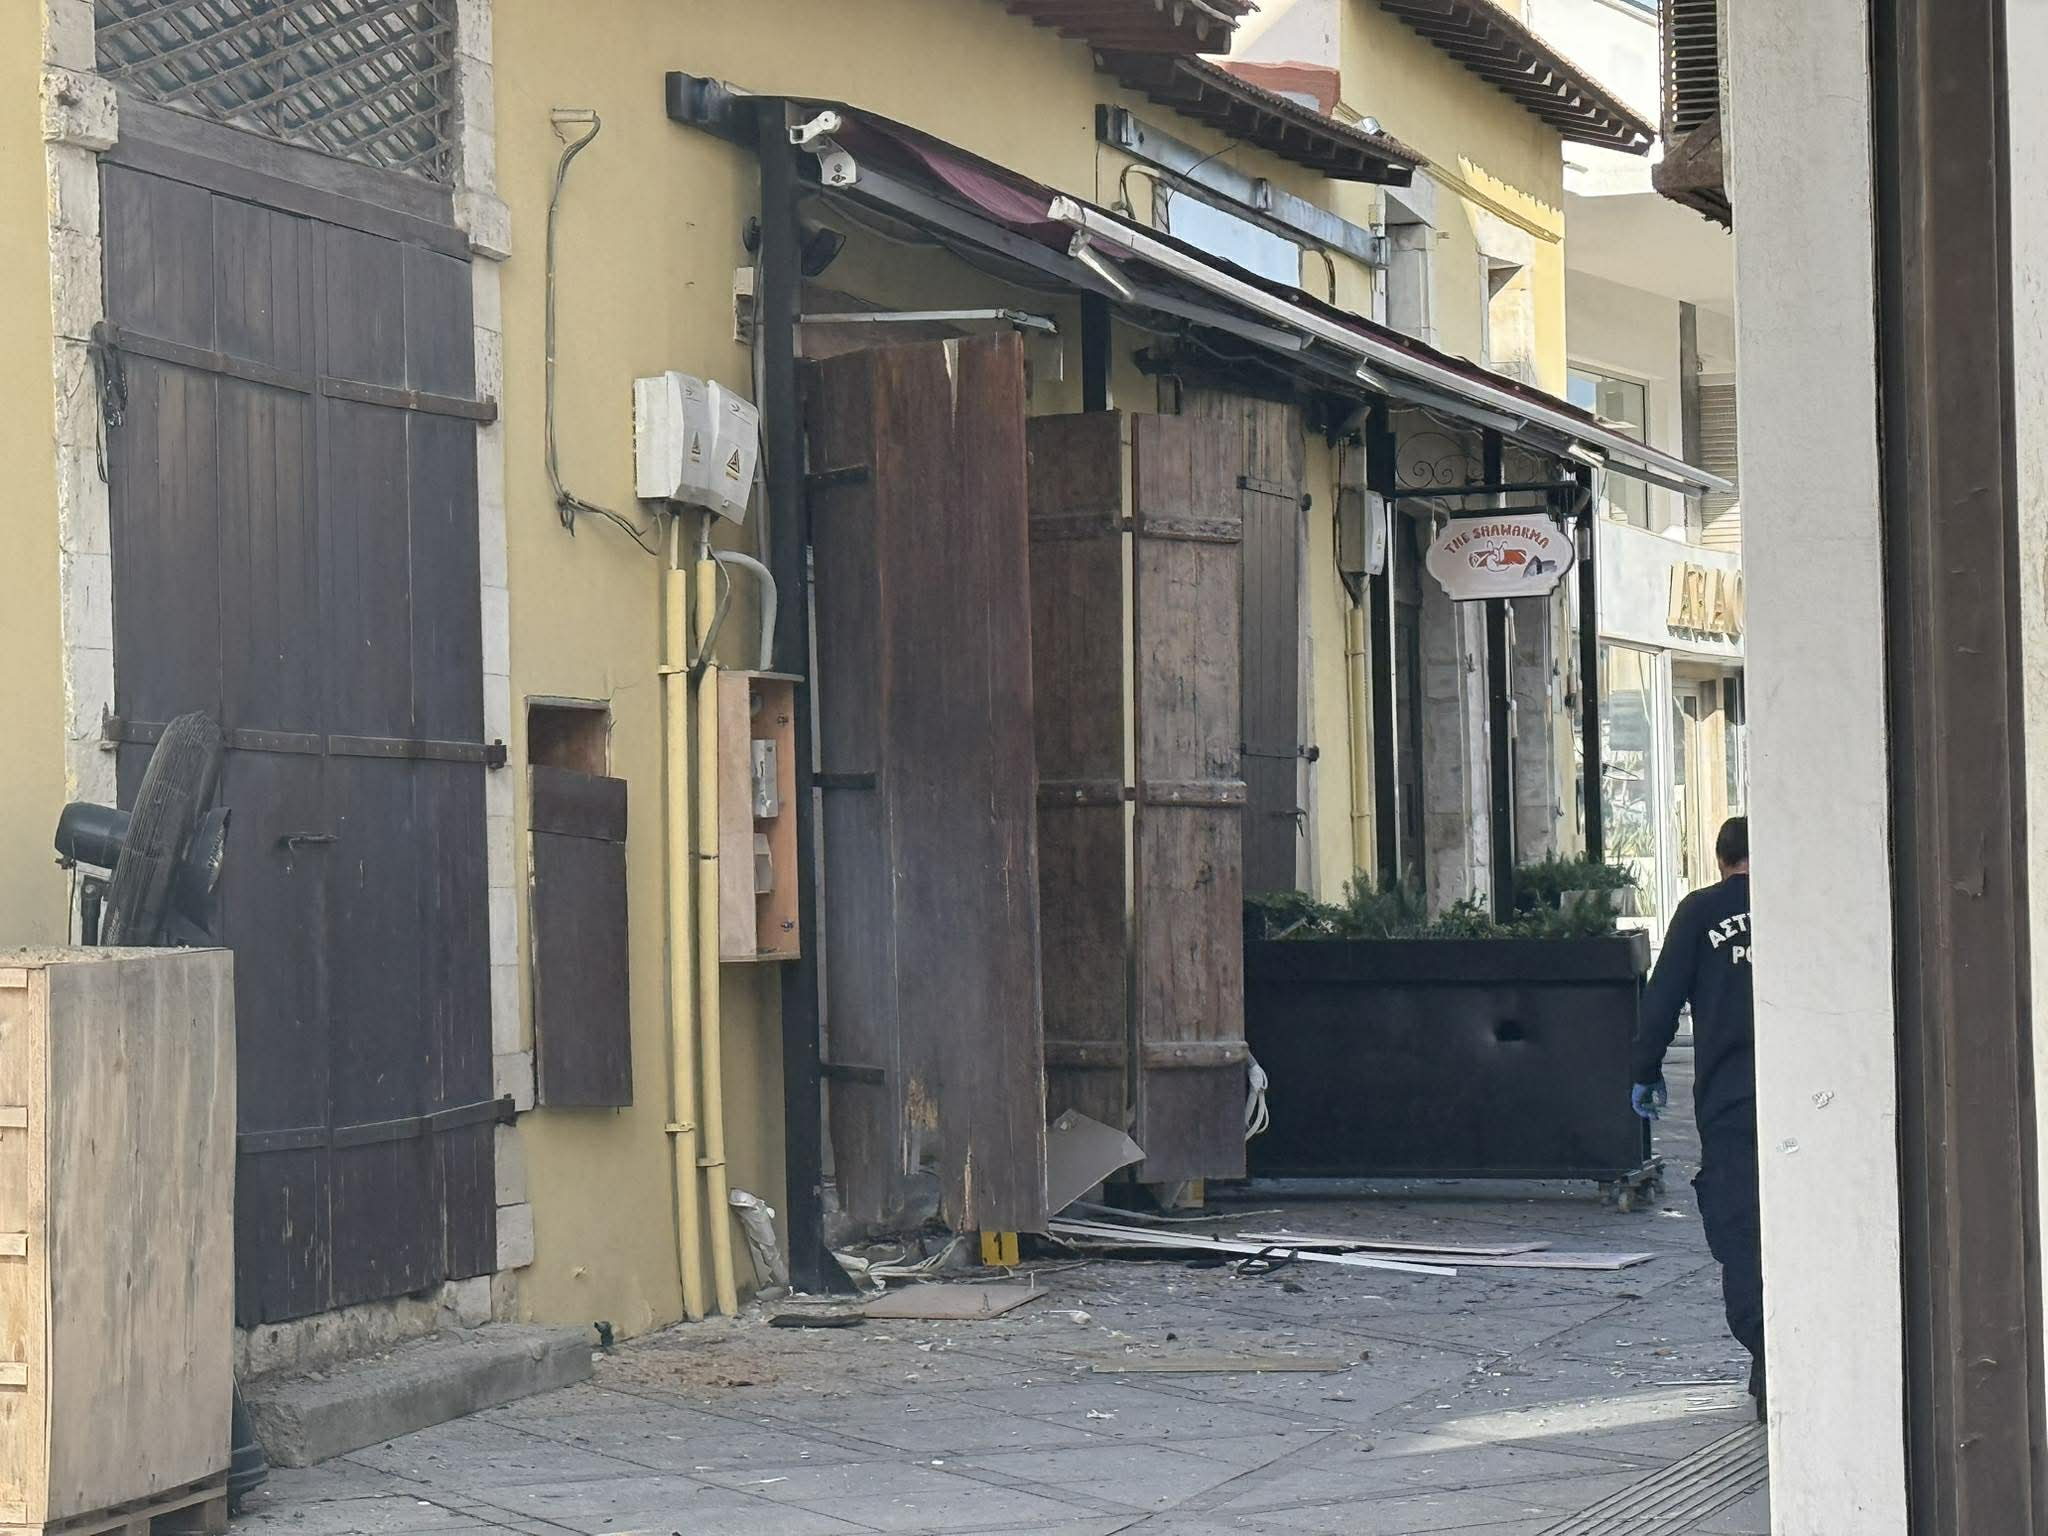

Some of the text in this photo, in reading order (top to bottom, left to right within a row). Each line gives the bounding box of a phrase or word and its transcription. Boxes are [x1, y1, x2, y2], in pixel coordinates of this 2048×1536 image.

[1443, 523, 1551, 554] THE SHAWARMA
[1708, 912, 1751, 949] ΑΣΤ
[993, 1231, 1003, 1261] 1
